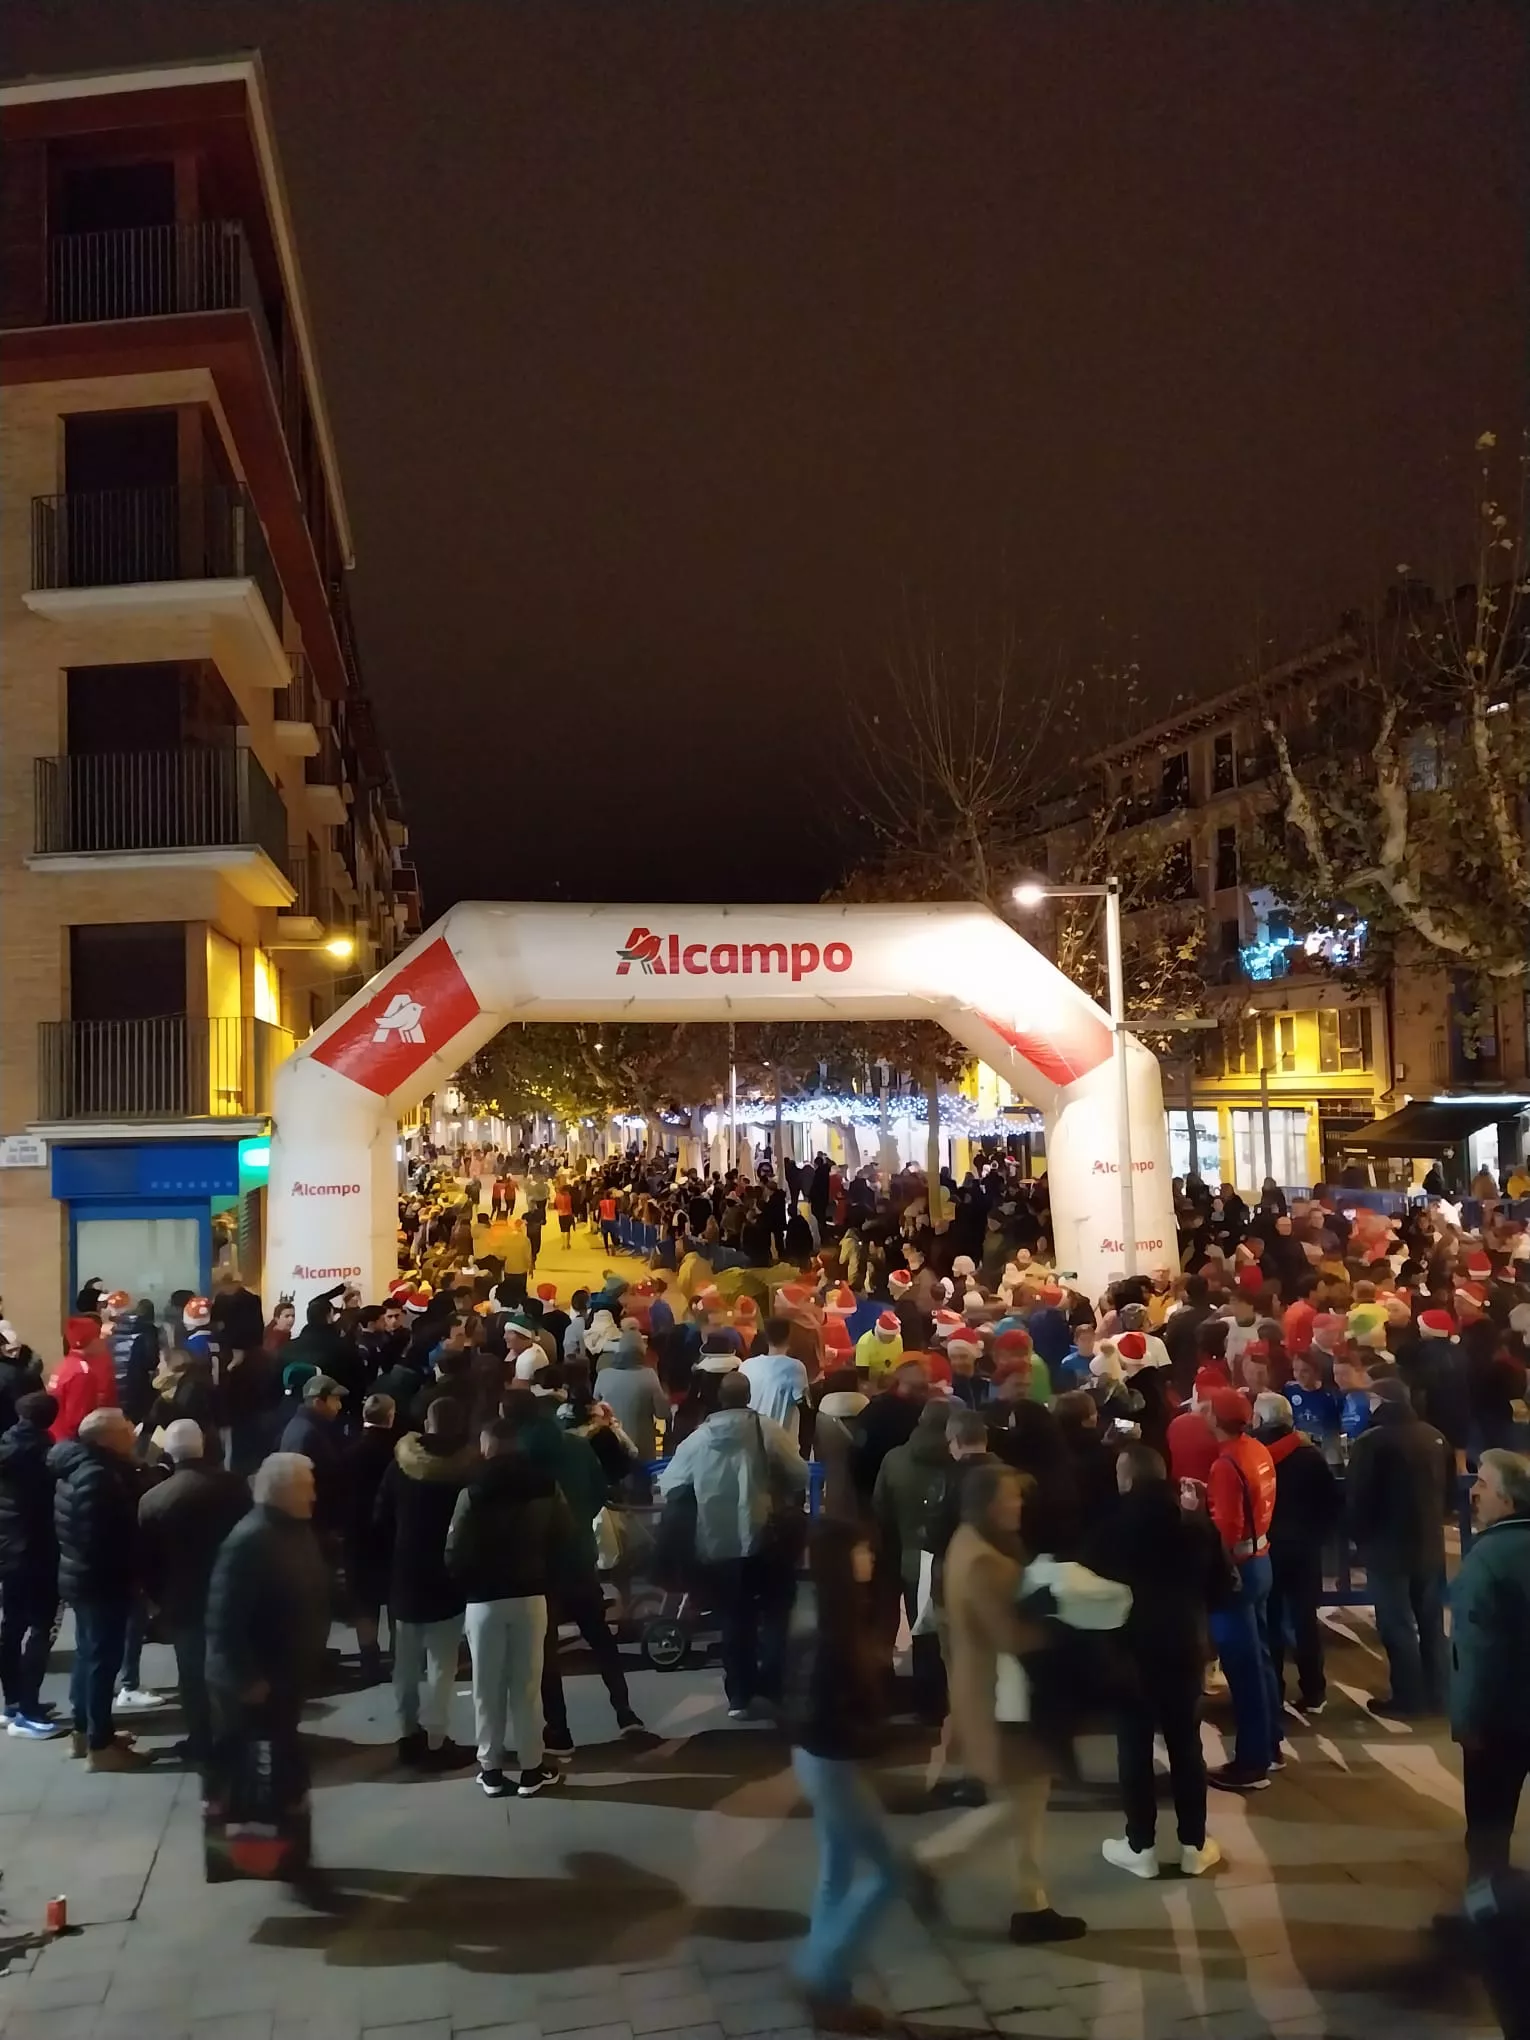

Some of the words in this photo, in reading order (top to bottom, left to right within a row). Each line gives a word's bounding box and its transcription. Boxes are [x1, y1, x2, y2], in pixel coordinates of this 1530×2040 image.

[616, 928, 853, 981] Alcampo
[1092, 1160, 1155, 1174] Alcmpo
[291, 1181, 361, 1196] Alcampo
[1100, 1239, 1163, 1253] Alcmpo
[292, 1265, 361, 1279] Alcampo
